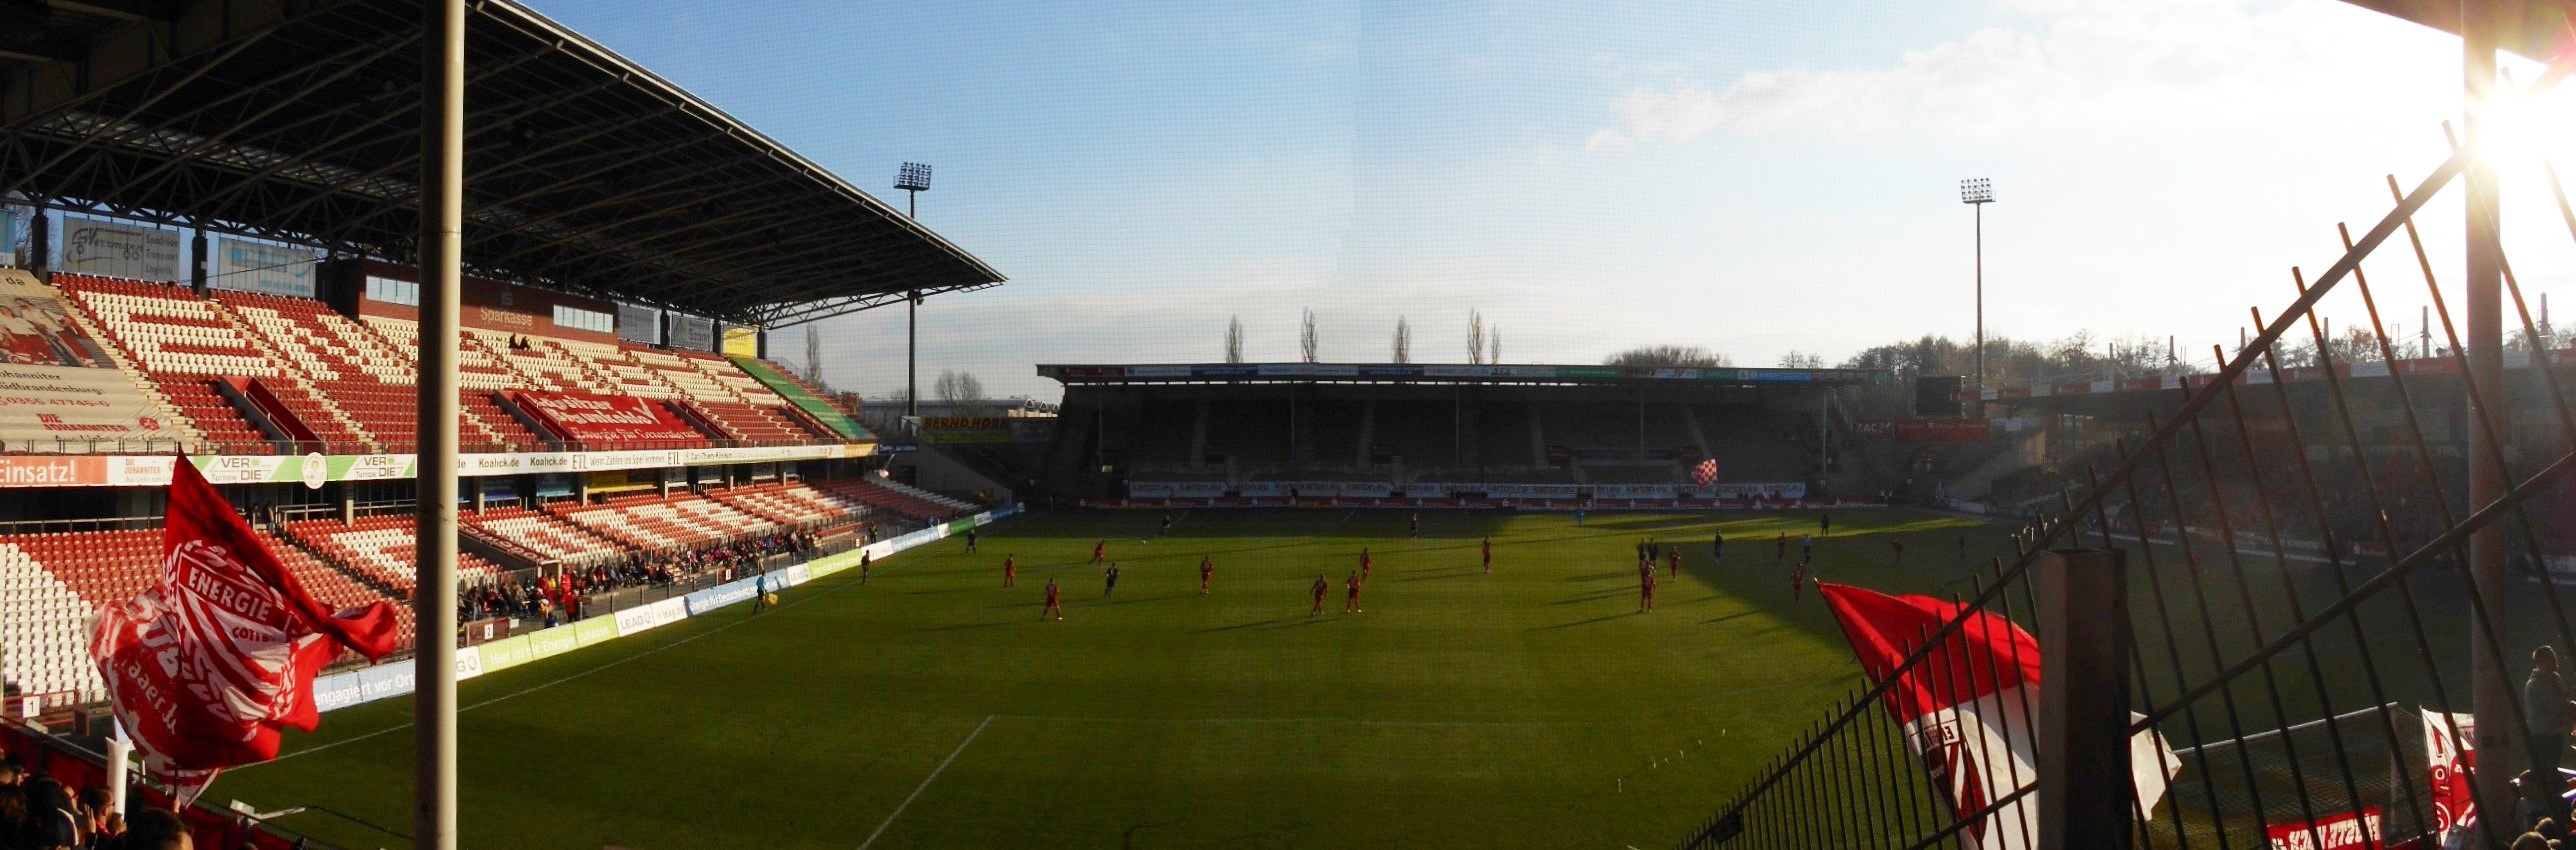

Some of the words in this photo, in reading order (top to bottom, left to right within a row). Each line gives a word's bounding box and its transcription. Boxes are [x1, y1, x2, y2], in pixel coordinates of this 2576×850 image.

[480, 306, 533, 327] Sparkasse
[36, 413, 63, 424] DIE
[923, 417, 969, 429] BERND
[43, 423, 130, 432] JOHANNITER
[220, 457, 250, 468] VER
[364, 456, 386, 466] VER
[478, 458, 520, 468] Koalick.de
[530, 456, 567, 467] Koalick.de
[572, 454, 588, 470] ETL
[667, 451, 681, 465] ETL
[0, 458, 75, 483] Einsatz!
[124, 466, 161, 475] JOHANNITER
[240, 469, 262, 481] DIE
[378, 467, 396, 477] DIE
[211, 473, 237, 482] Turnow
[188, 567, 273, 622] ENERGIE
[620, 616, 643, 630] LEAG
[313, 682, 372, 706] engagiert
[373, 678, 393, 693] vor
[395, 673, 415, 689] Ort
